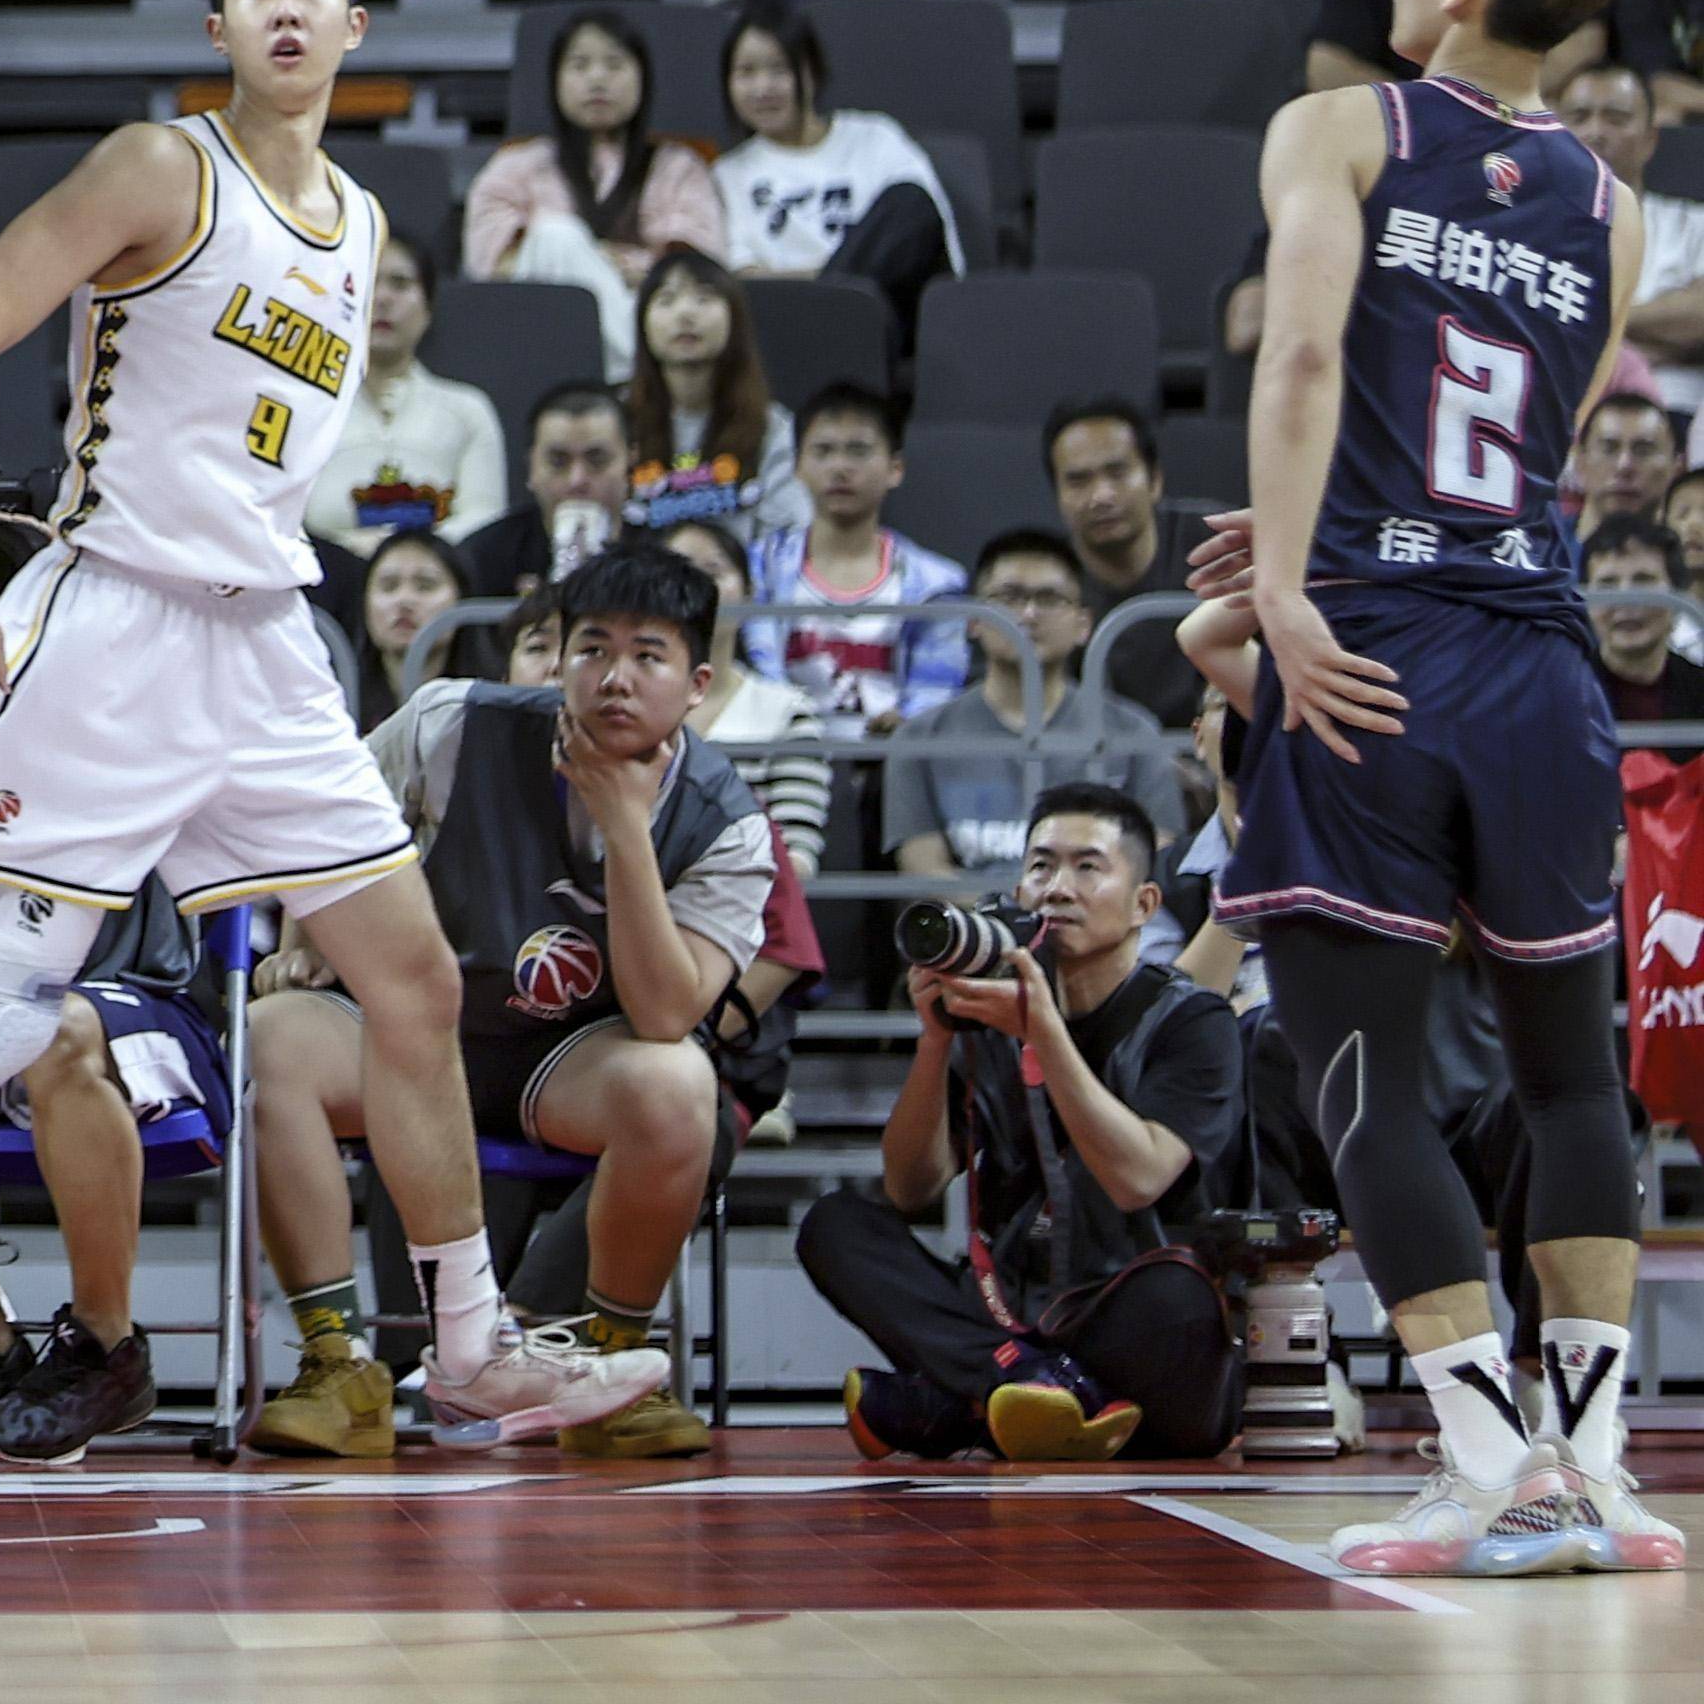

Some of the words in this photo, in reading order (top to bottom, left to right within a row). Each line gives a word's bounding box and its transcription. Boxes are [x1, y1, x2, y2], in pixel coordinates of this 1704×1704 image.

[1375, 206, 1593, 324] 昊铂汽车
[212, 282, 352, 400] LIONS
[245, 392, 286, 472] 9
[1426, 314, 1531, 518] 2
